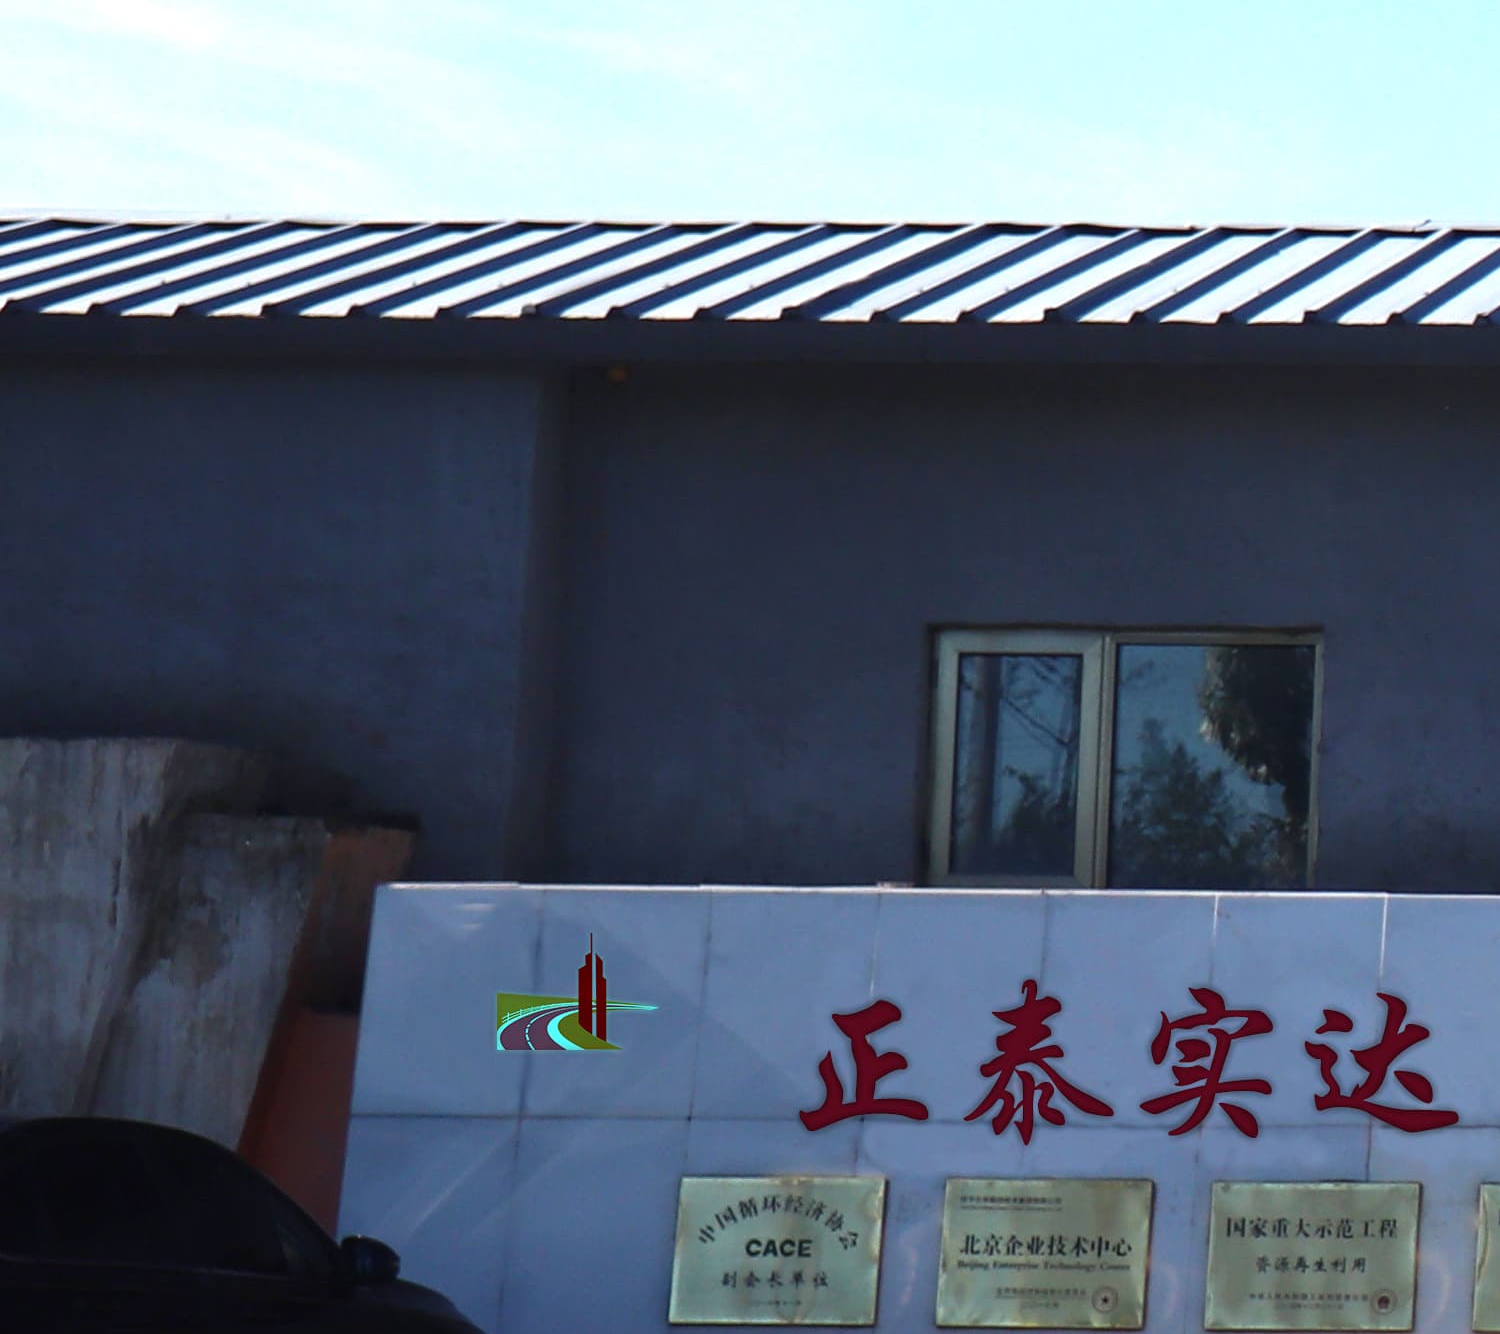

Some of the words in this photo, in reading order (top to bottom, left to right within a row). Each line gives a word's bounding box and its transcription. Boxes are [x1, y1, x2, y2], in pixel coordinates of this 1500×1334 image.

[698, 1194, 859, 1250] 中国循环经济协会
[1226, 1217, 1398, 1239] 国家重大示范工程
[745, 1238, 813, 1258] CACE
[959, 1234, 1132, 1258] 北京企业技术中心
[1255, 1256, 1367, 1274] 资源再生利用
[721, 1271, 829, 1289] 副会长单位
